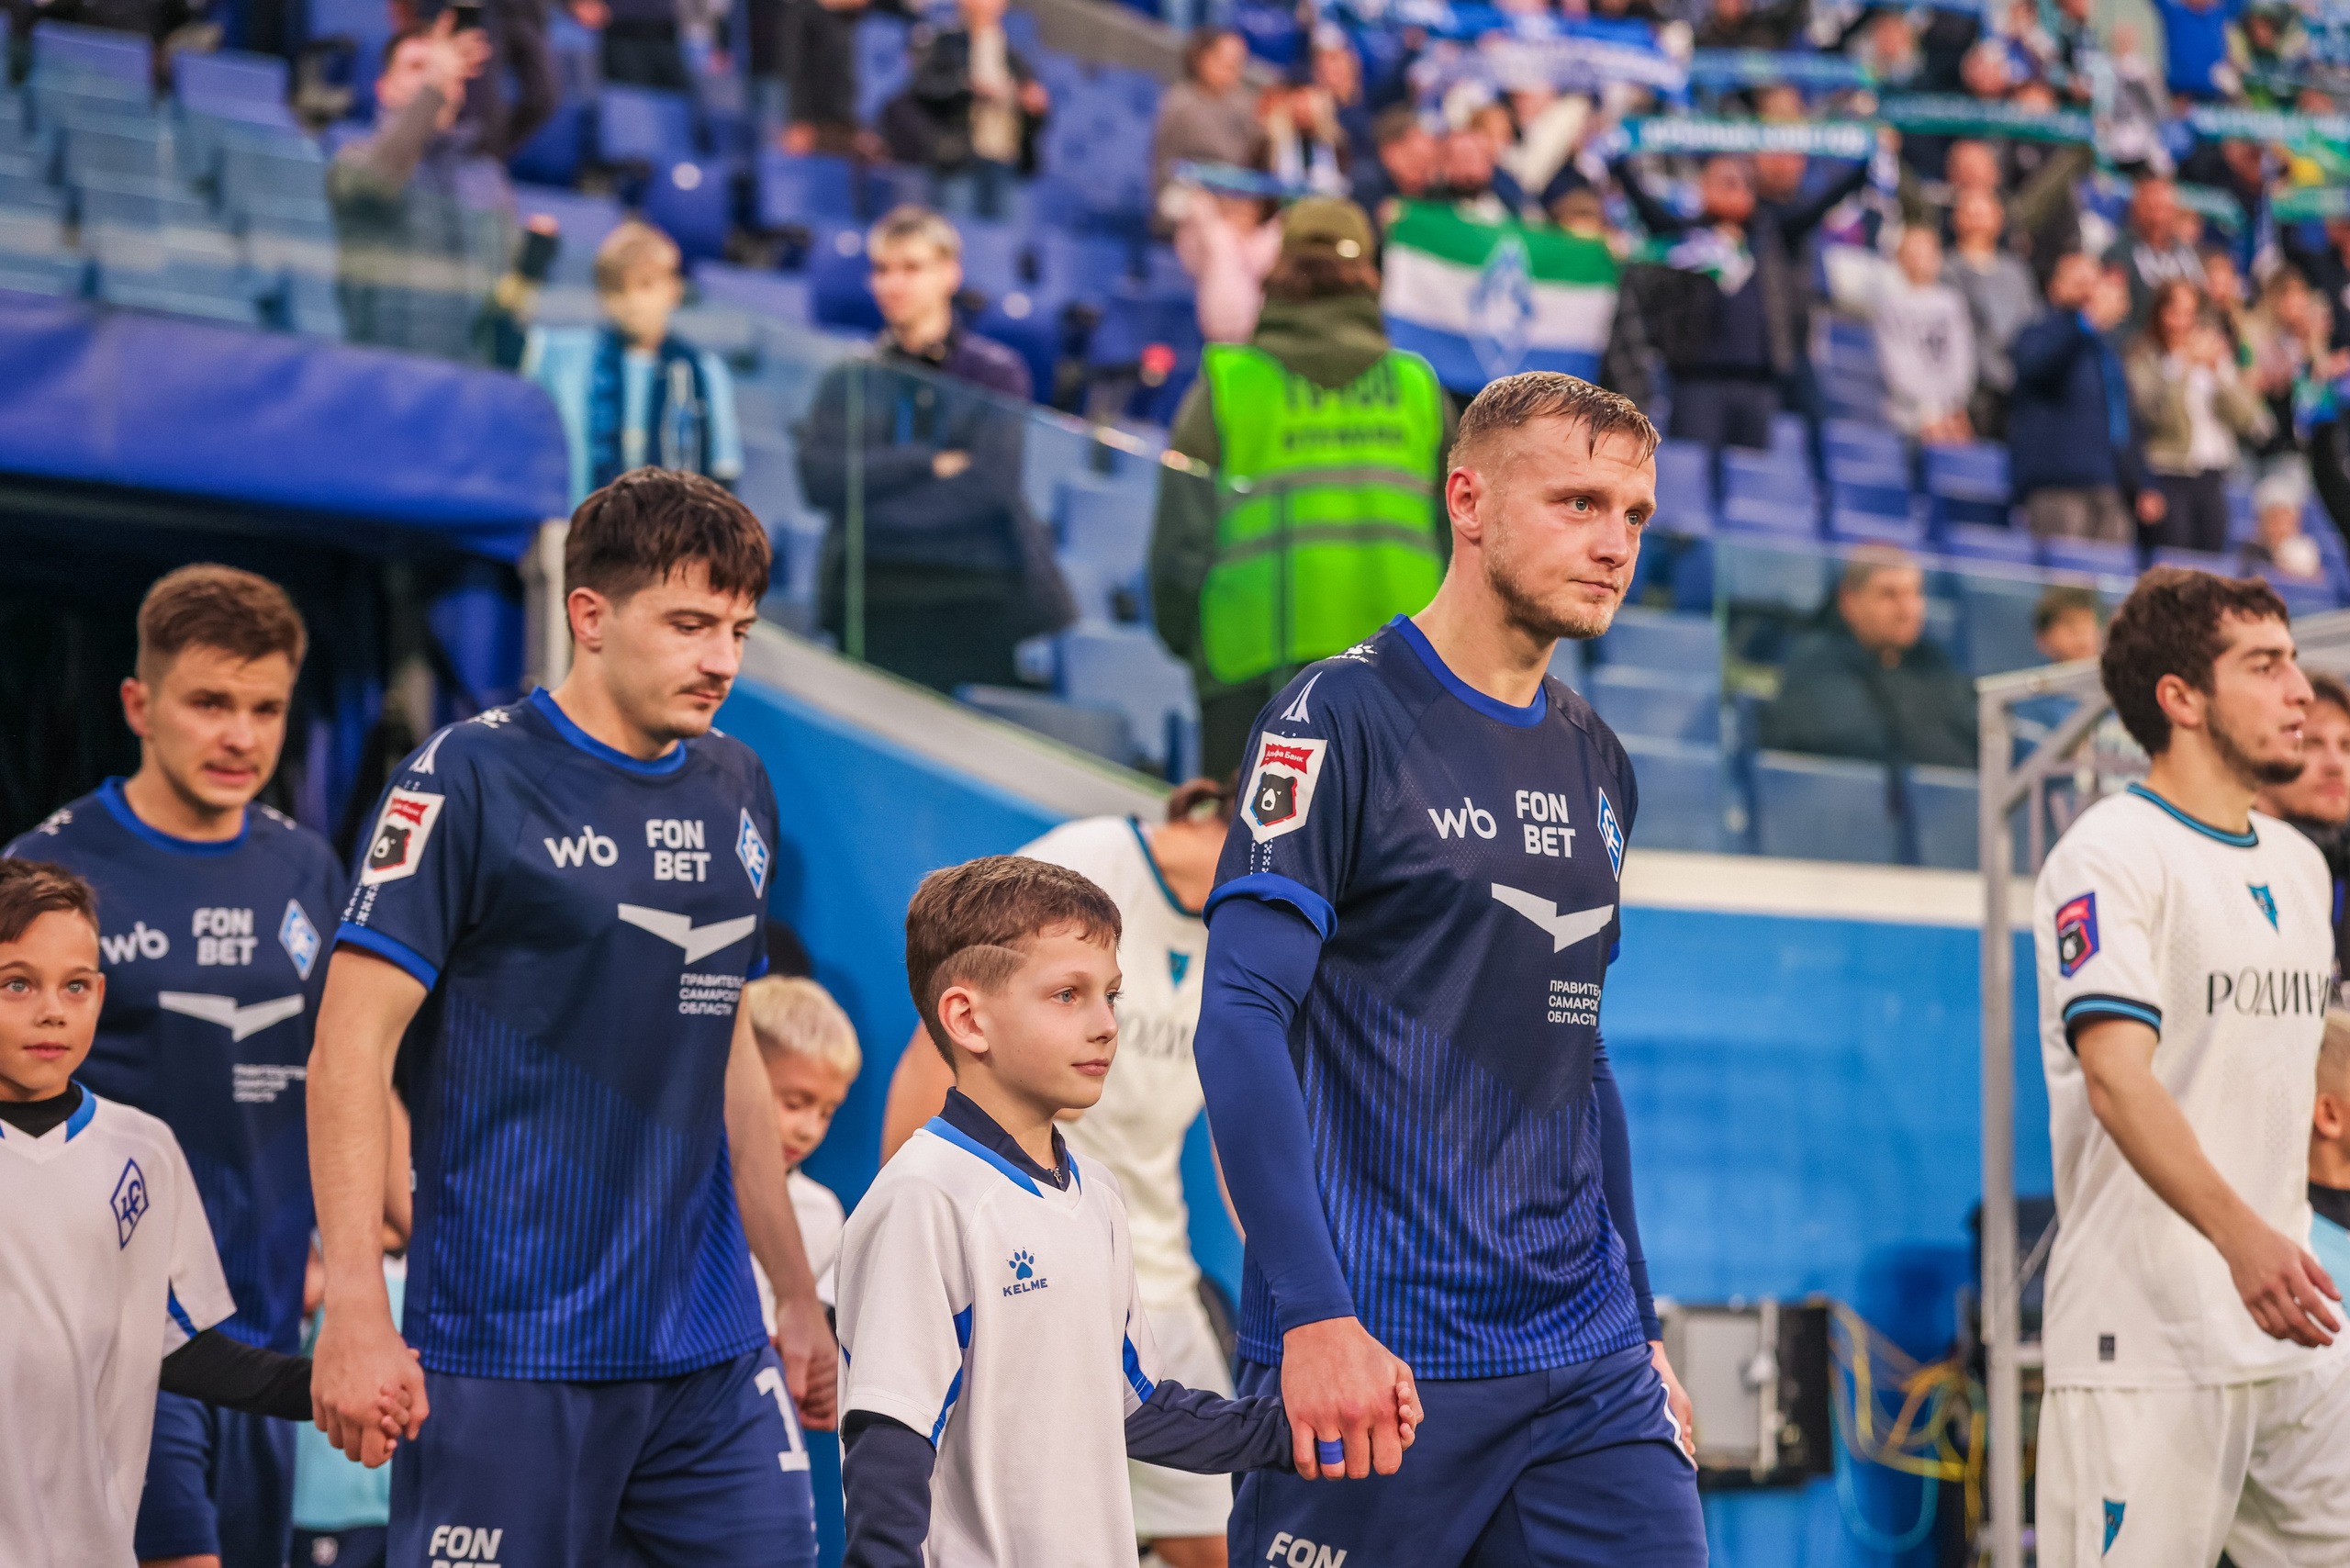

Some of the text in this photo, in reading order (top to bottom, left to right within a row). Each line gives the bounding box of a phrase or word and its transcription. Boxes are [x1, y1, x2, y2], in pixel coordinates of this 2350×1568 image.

[1515, 789, 1570, 824] FON
[645, 818, 706, 850] FON
[1523, 823, 1576, 858] BET
[654, 849, 711, 882] BET
[191, 907, 255, 938] FON
[196, 935, 260, 966] BET
[1002, 1278, 1048, 1297] KELME
[429, 1525, 504, 1561] FON
[1266, 1531, 1348, 1568] FON
